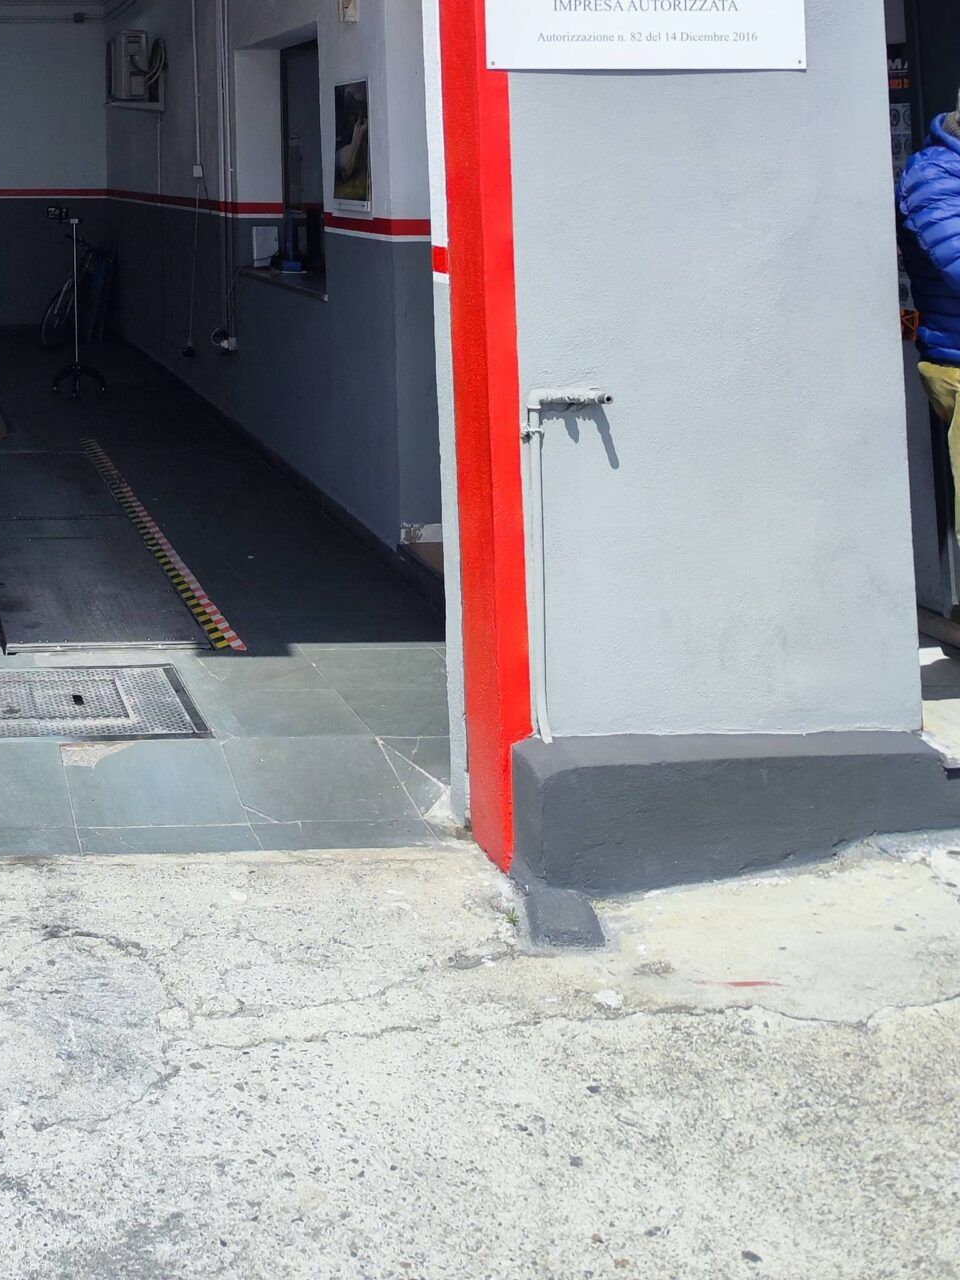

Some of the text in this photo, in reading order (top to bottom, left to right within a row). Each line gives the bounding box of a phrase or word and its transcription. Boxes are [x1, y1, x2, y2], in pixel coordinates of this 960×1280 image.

[553, 0, 739, 12] IMPRESA AUTORIZZATA
[537, 31, 758, 42] Autorizzazione n. 82 del 14 Dicembre 2016
